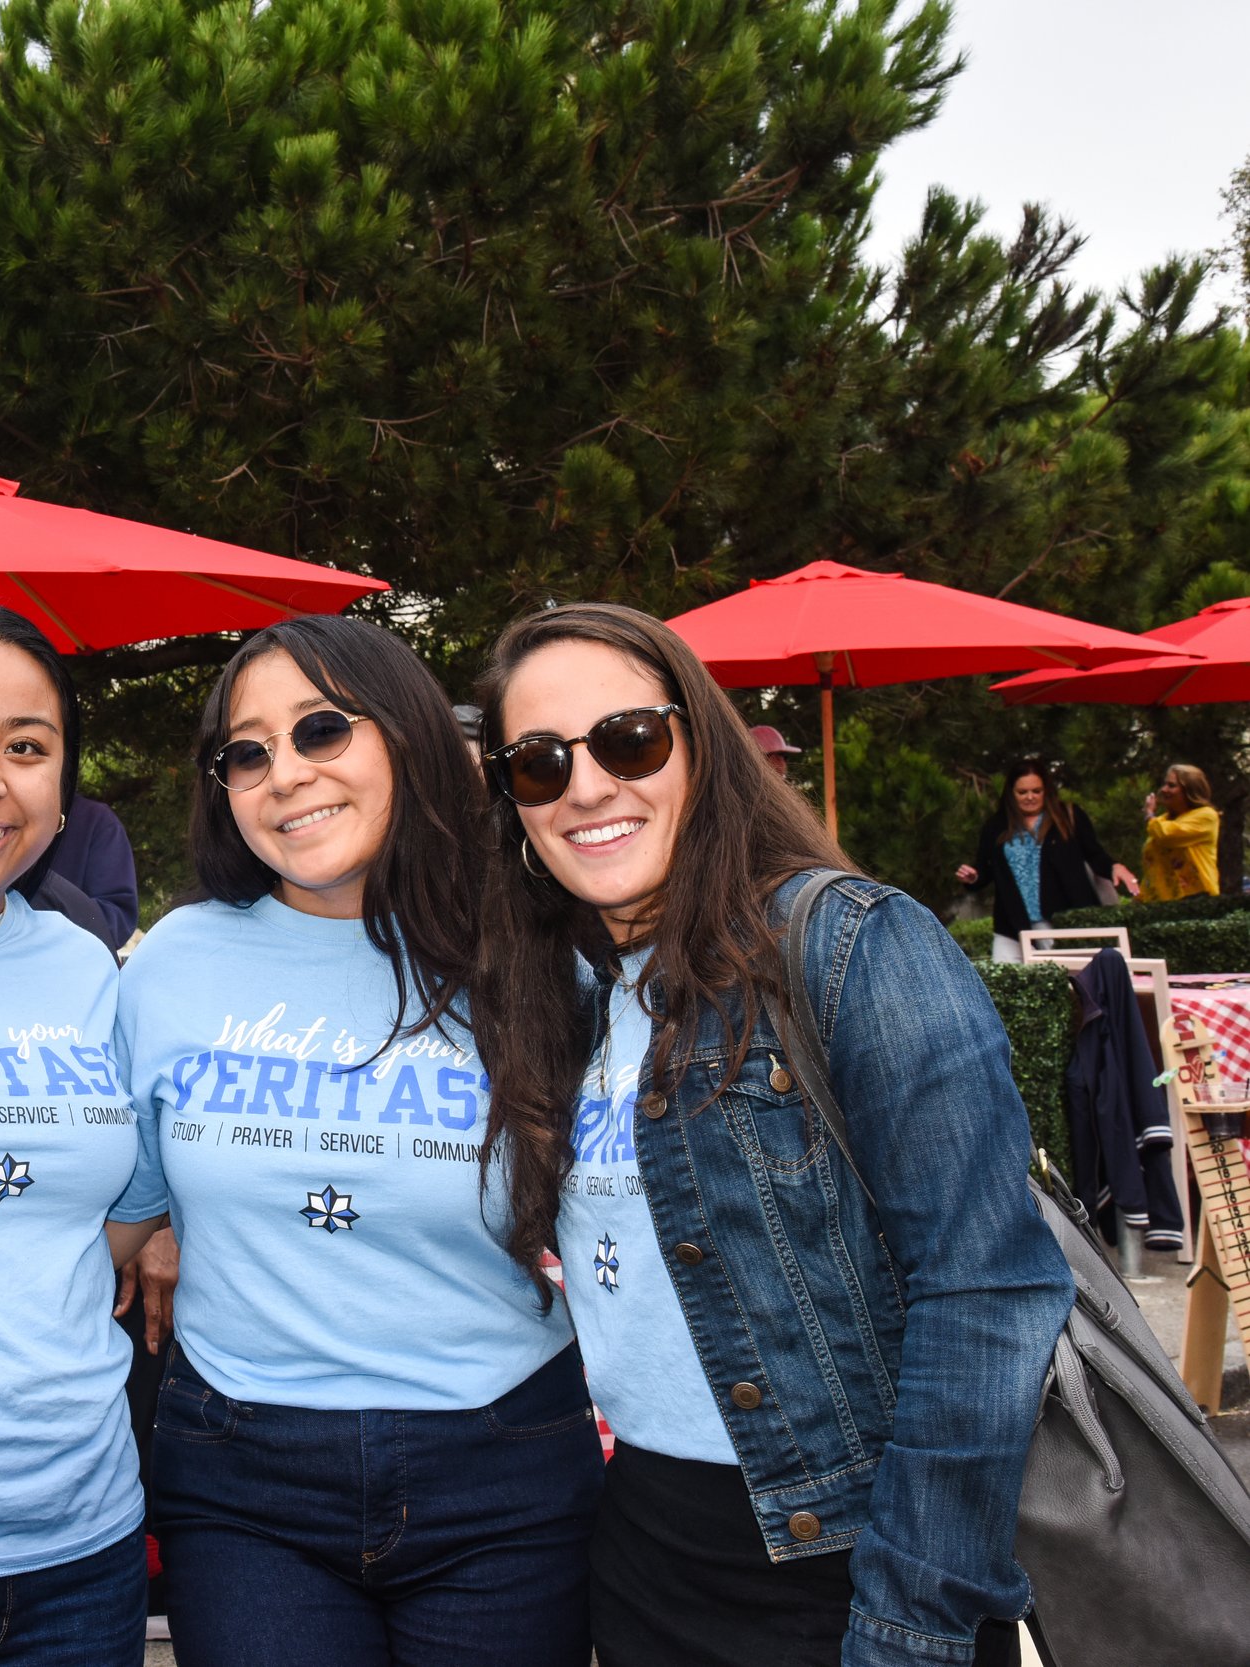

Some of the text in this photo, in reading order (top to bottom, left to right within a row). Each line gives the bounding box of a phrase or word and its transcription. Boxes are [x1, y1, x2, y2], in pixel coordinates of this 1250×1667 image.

[8, 1022, 83, 1059] your
[213, 1002, 475, 1080] What is your
[171, 1121, 206, 1143] STUDY
[231, 1126, 293, 1149] PRAYER
[319, 1132, 385, 1155] SERVICE
[586, 1176, 616, 1196] SERVICE
